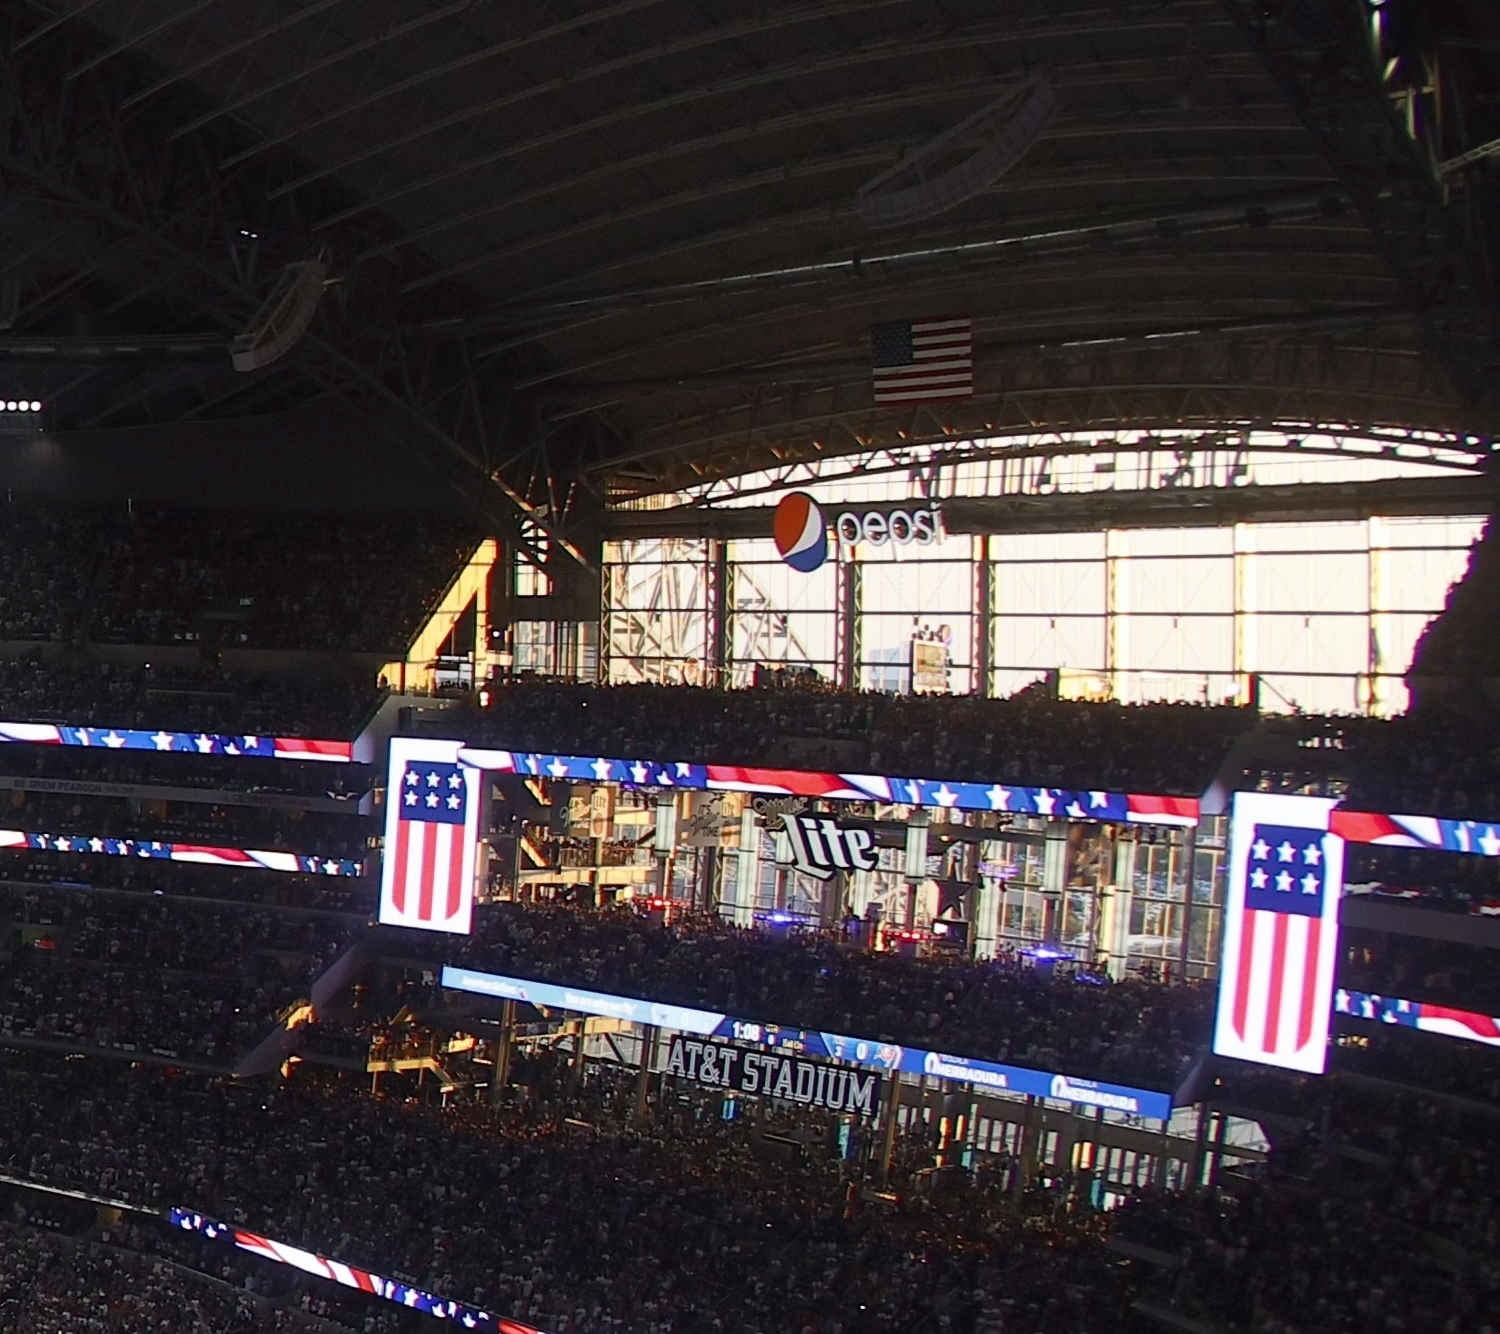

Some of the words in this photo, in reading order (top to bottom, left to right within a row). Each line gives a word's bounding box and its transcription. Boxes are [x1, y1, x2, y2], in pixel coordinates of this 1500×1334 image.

[836, 500, 943, 562] pepsi
[777, 811, 879, 883] Lite
[732, 1022, 760, 1041] 1:08
[857, 1043, 868, 1059] 0
[668, 1038, 738, 1088] AT&T
[741, 1052, 876, 1116] STADIUM
[938, 1063, 1008, 1088] HERRADURA
[1065, 1086, 1138, 1112] HERRADURA
